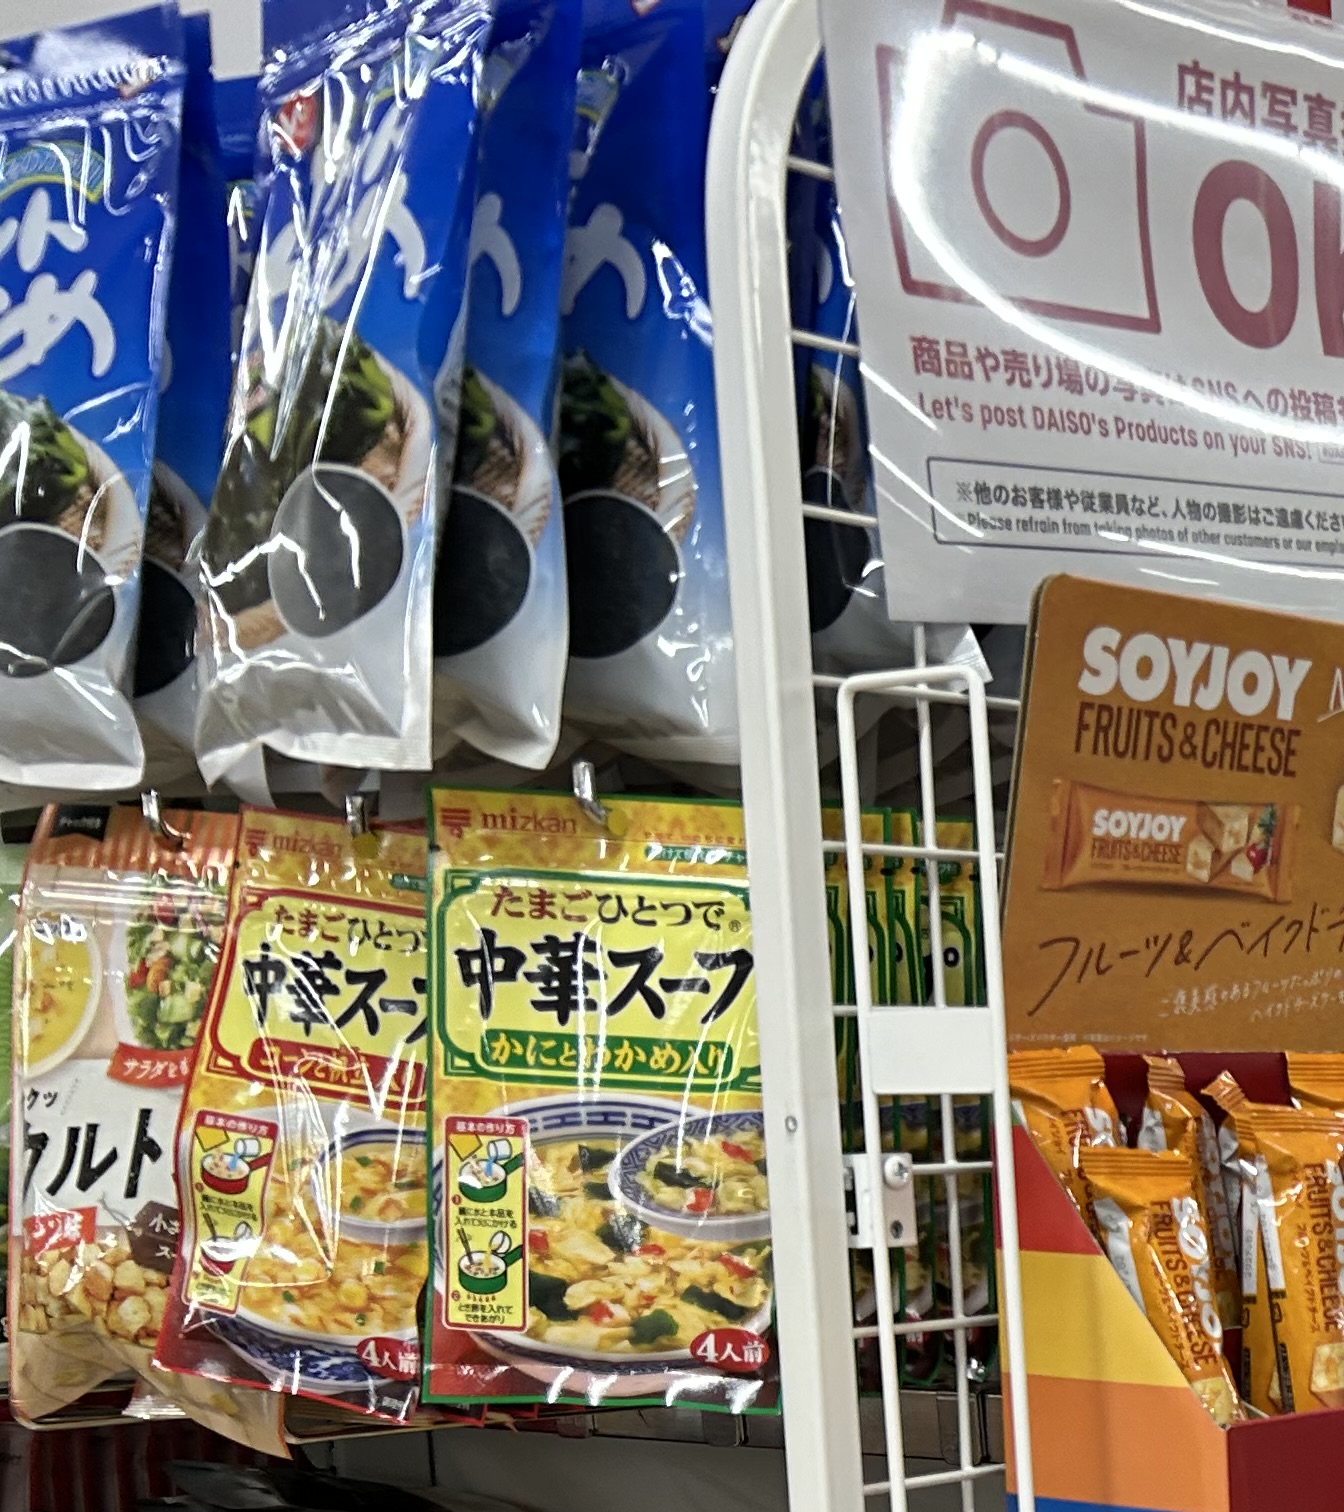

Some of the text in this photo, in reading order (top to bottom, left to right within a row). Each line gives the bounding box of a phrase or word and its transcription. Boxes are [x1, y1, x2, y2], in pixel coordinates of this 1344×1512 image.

[918, 392, 1312, 460] Let's post DAISO's Products on your SNS!
[1078, 625, 1313, 721] SOYJOY
[480, 806, 578, 834] mizkan
[1092, 808, 1187, 841] SOYJOY
[491, 1032, 724, 1075] かにとわかめ入り
[694, 1331, 765, 1366] 4人前
